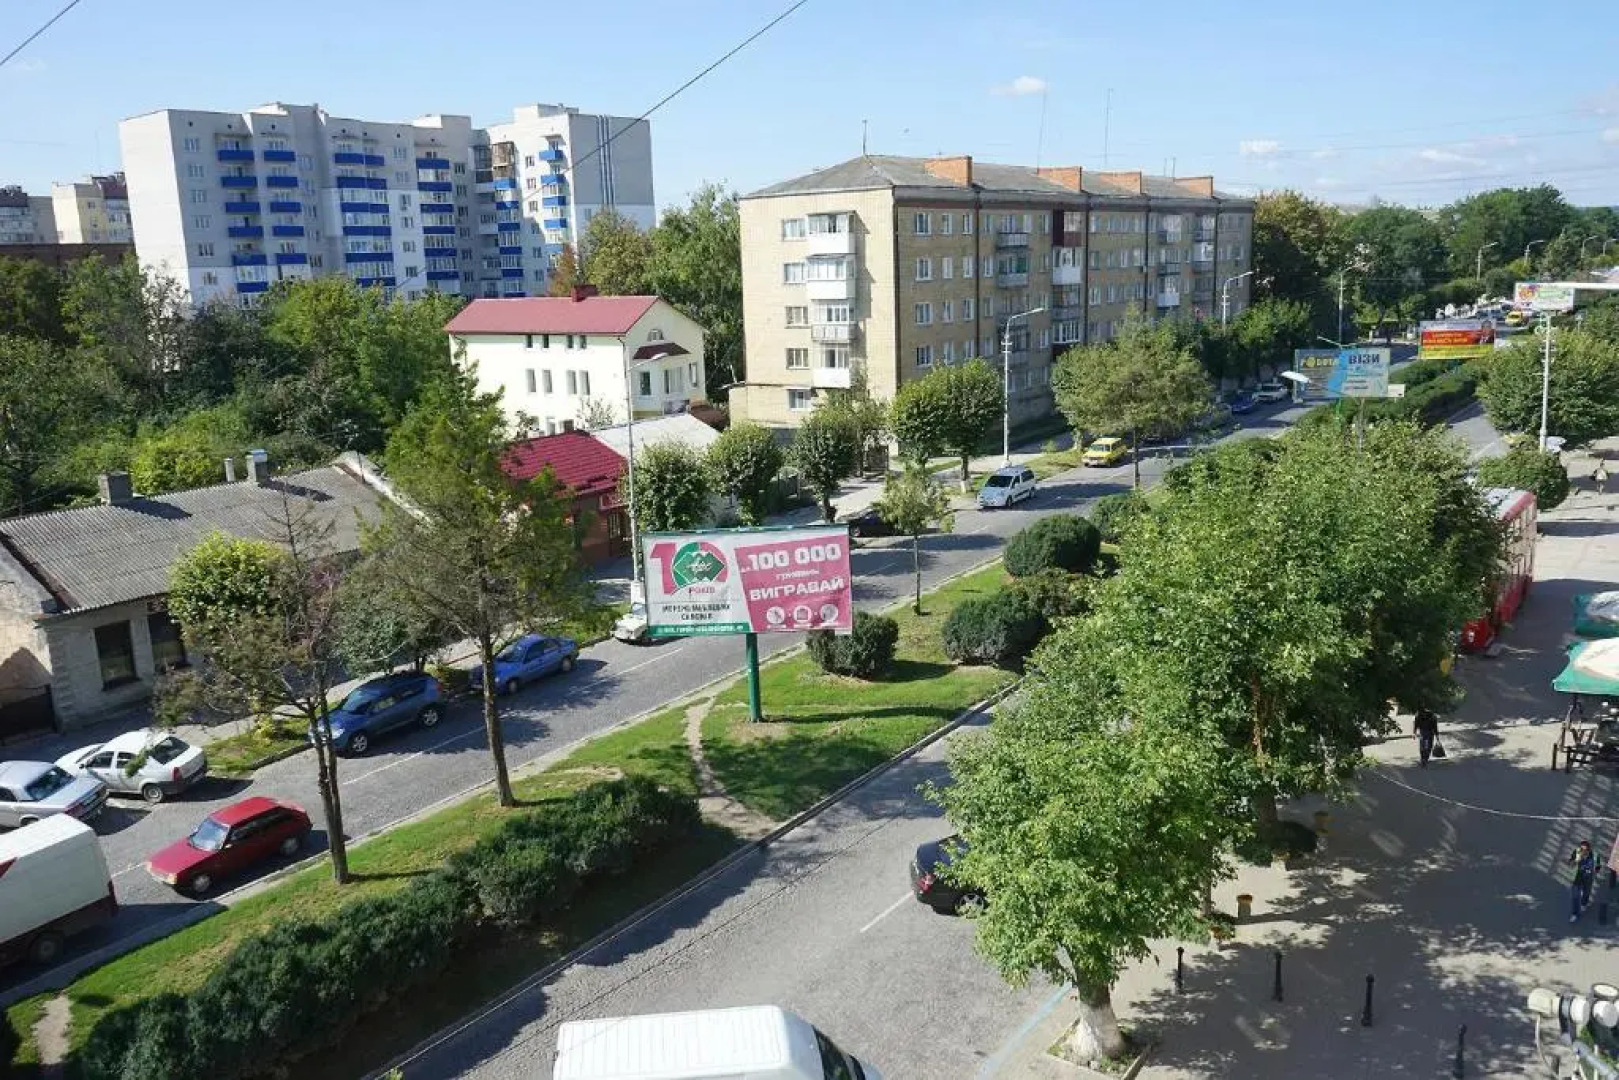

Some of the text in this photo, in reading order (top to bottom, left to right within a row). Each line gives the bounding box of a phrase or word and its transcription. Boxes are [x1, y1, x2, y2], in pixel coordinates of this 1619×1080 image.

[1349, 354, 1380, 364] ВІЗИ
[747, 543, 842, 570] 100 000
[749, 576, 845, 601] ВИГРАВАЙ
